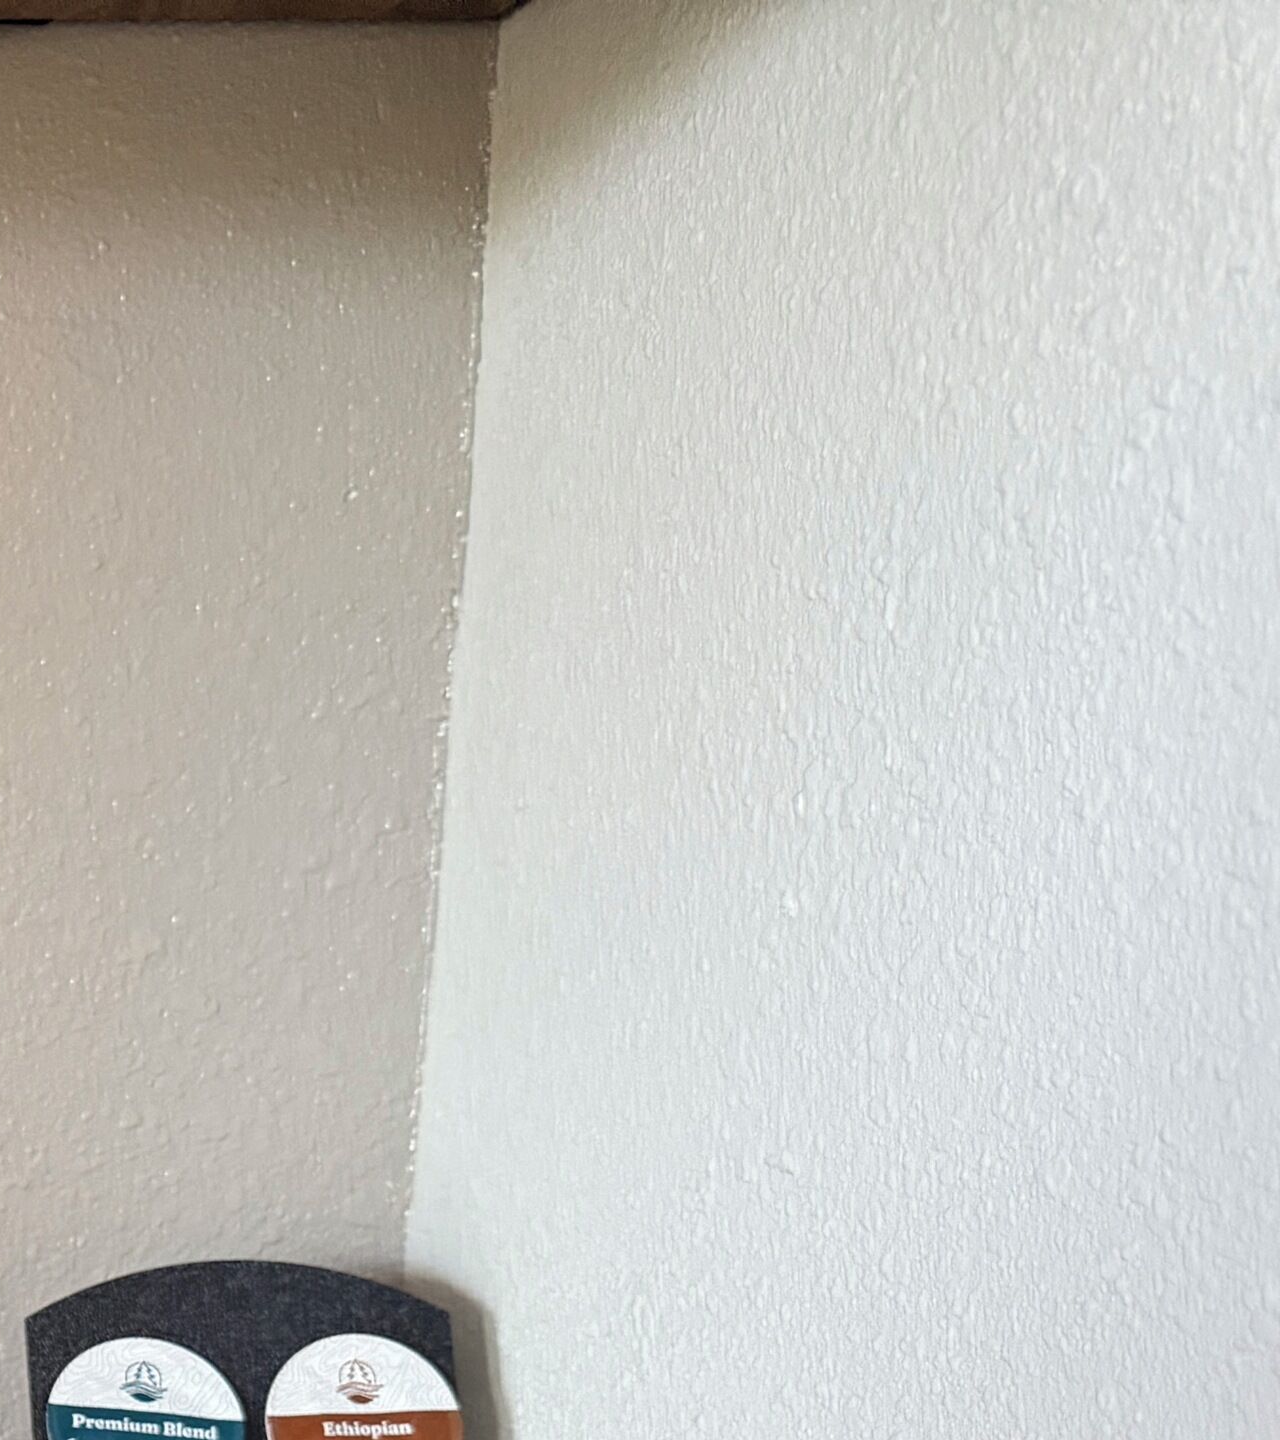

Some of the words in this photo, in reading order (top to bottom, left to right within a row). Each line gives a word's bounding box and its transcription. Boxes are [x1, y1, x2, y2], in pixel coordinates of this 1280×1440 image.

[71, 1413, 161, 1436] Premium
[163, 1420, 218, 1440] Blend
[322, 1420, 414, 1440] Ethiopian
